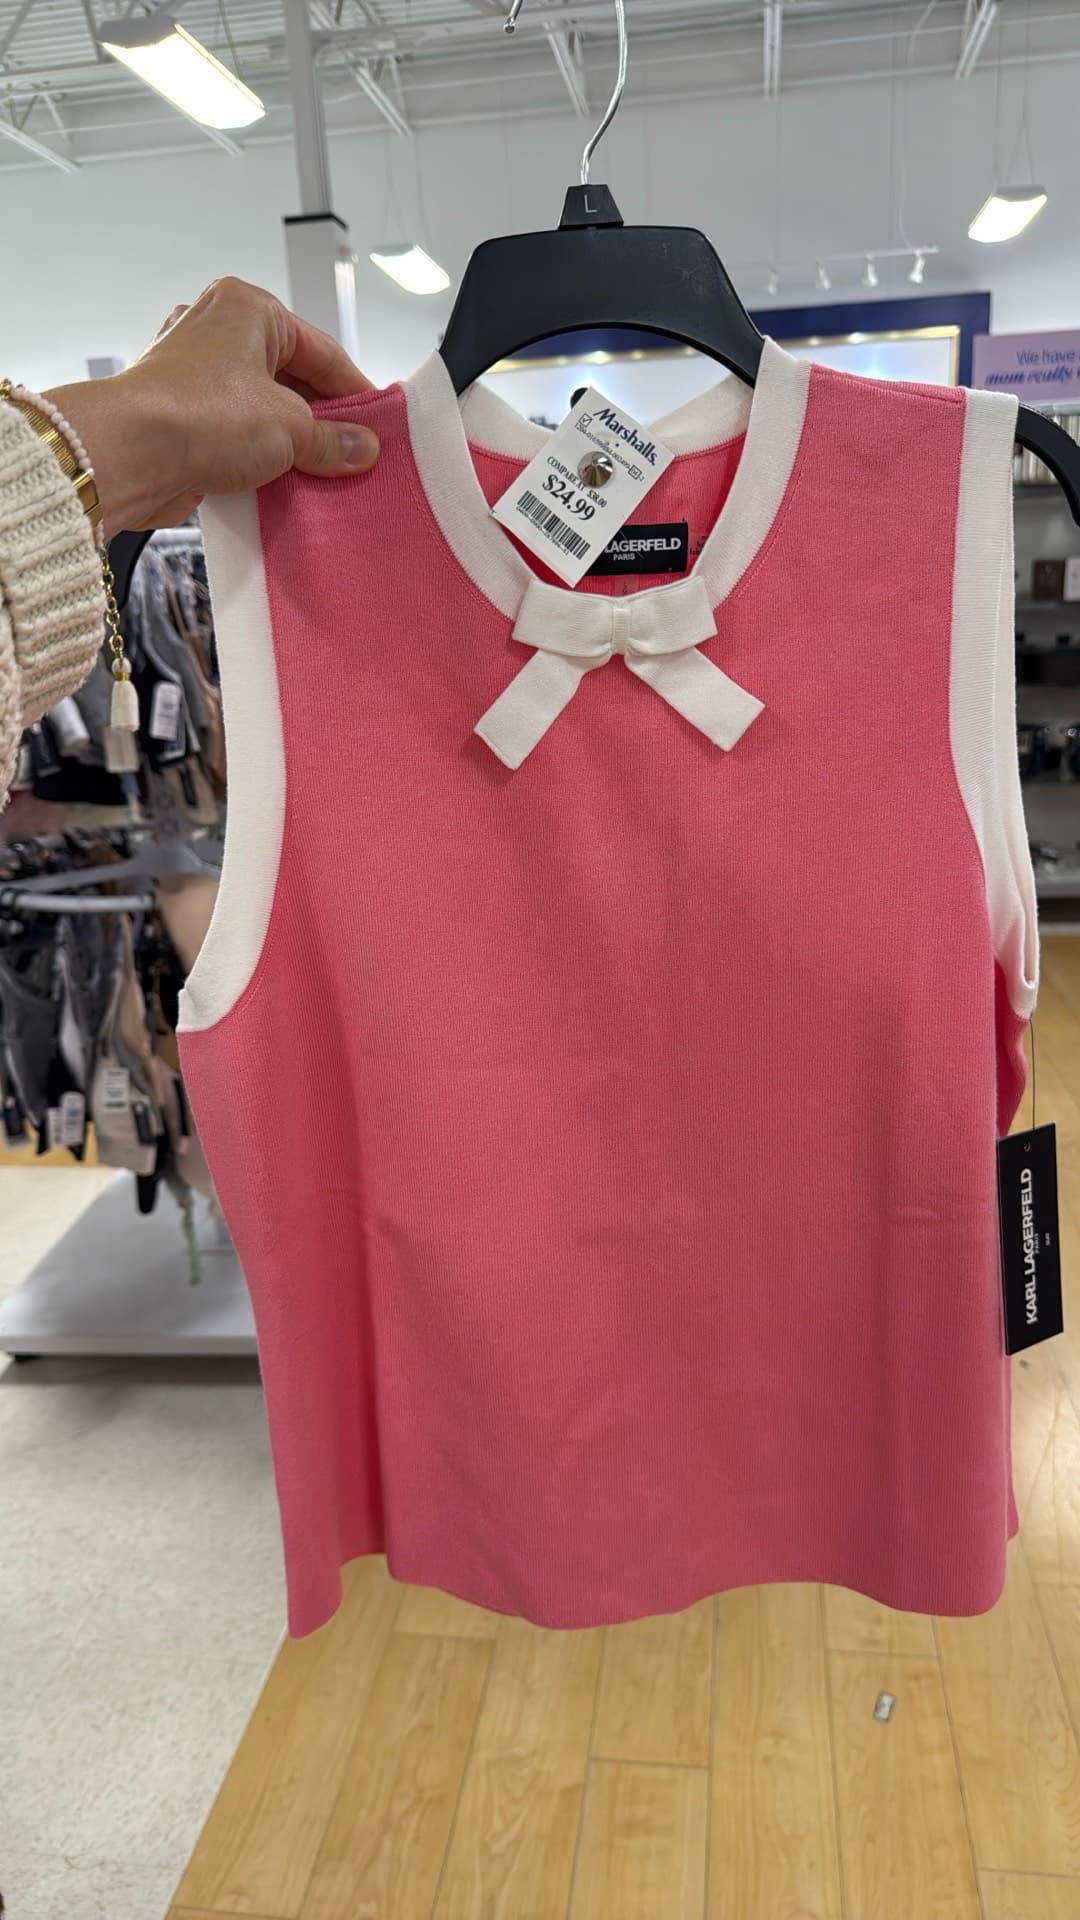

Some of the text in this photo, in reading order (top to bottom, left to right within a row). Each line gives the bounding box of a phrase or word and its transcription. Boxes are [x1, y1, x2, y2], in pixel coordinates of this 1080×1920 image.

[584, 194, 598, 214] L
[1016, 349, 1075, 365] We have
[542, 474, 594, 521] $24.99
[546, 456, 608, 509] COMPARE AT $38.00
[613, 553, 636, 561] PARIS
[1021, 1167, 1038, 1325] KARL LAGERFELD
